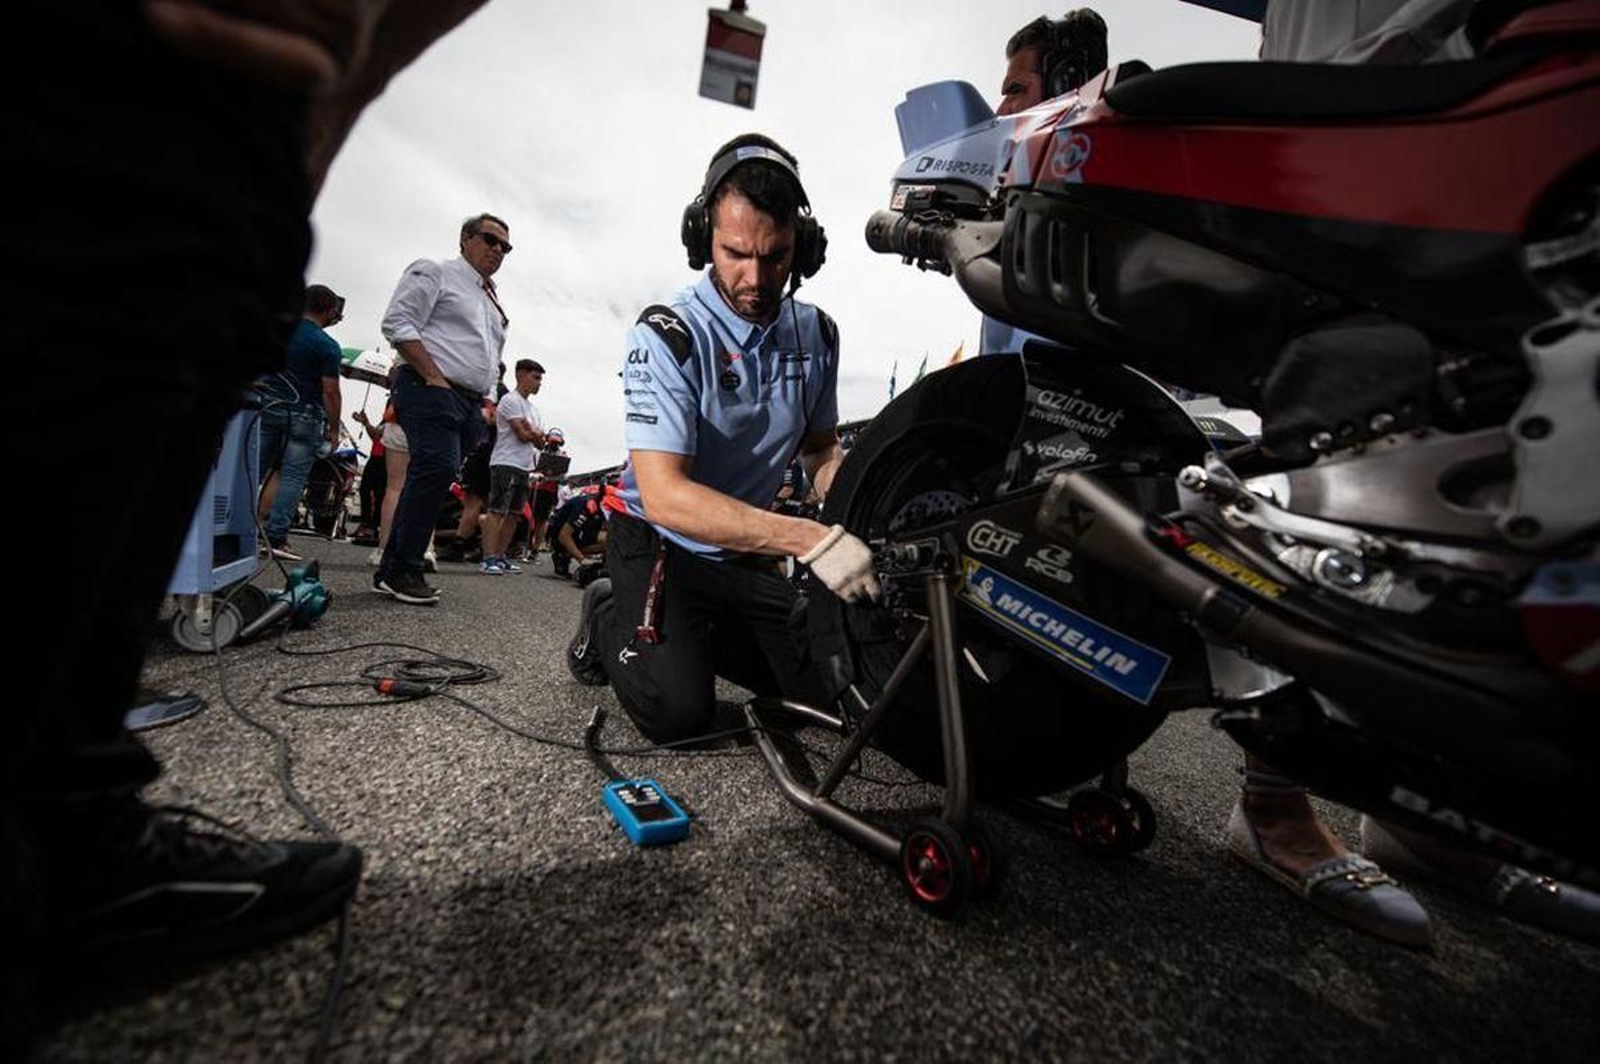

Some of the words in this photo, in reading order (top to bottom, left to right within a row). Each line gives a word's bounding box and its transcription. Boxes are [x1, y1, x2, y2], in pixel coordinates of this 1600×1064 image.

[933, 157, 994, 176] RISPOSTA
[1037, 389, 1125, 428] azimut
[1037, 443, 1098, 462] volofin
[971, 525, 1021, 556] CHT
[996, 593, 1138, 675] MICHELIN
